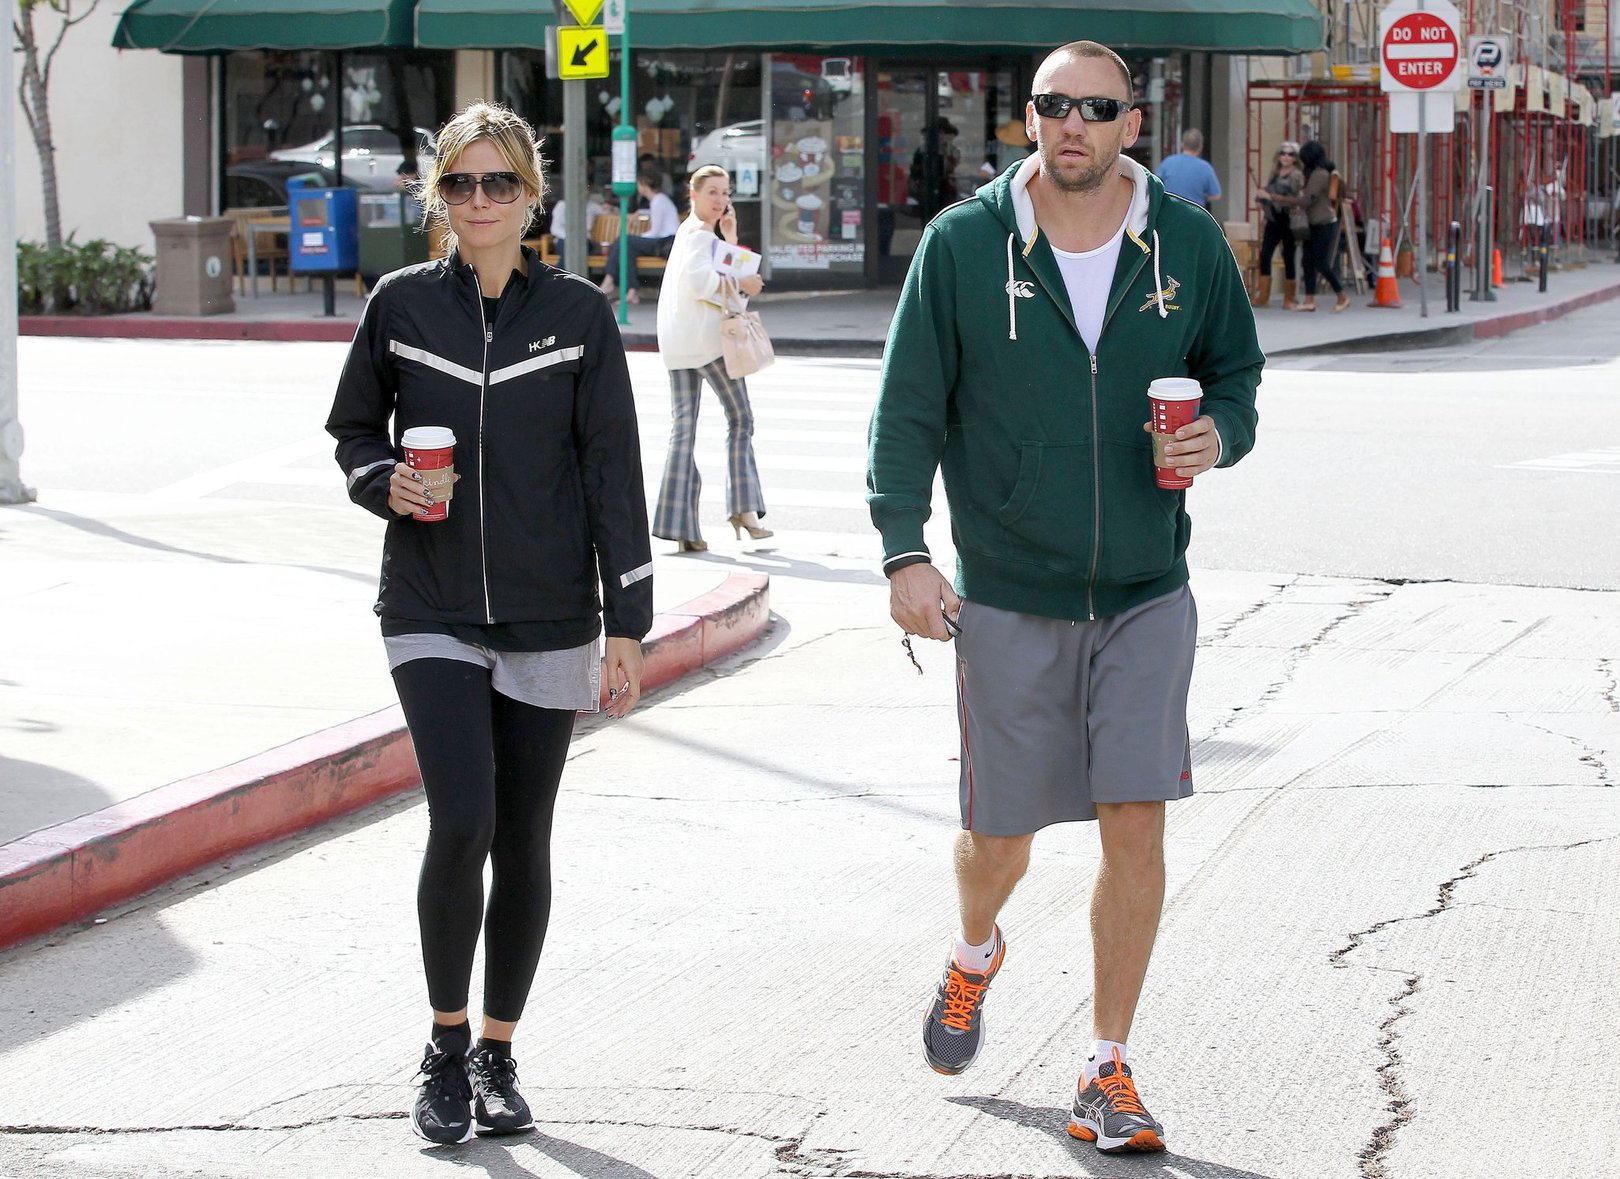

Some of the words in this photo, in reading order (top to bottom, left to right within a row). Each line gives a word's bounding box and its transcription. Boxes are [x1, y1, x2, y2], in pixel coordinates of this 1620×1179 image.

[1392, 27, 1412, 41] DO
[1420, 27, 1447, 40] NOT
[1398, 62, 1443, 76] ENTER
[742, 169, 752, 184] A
